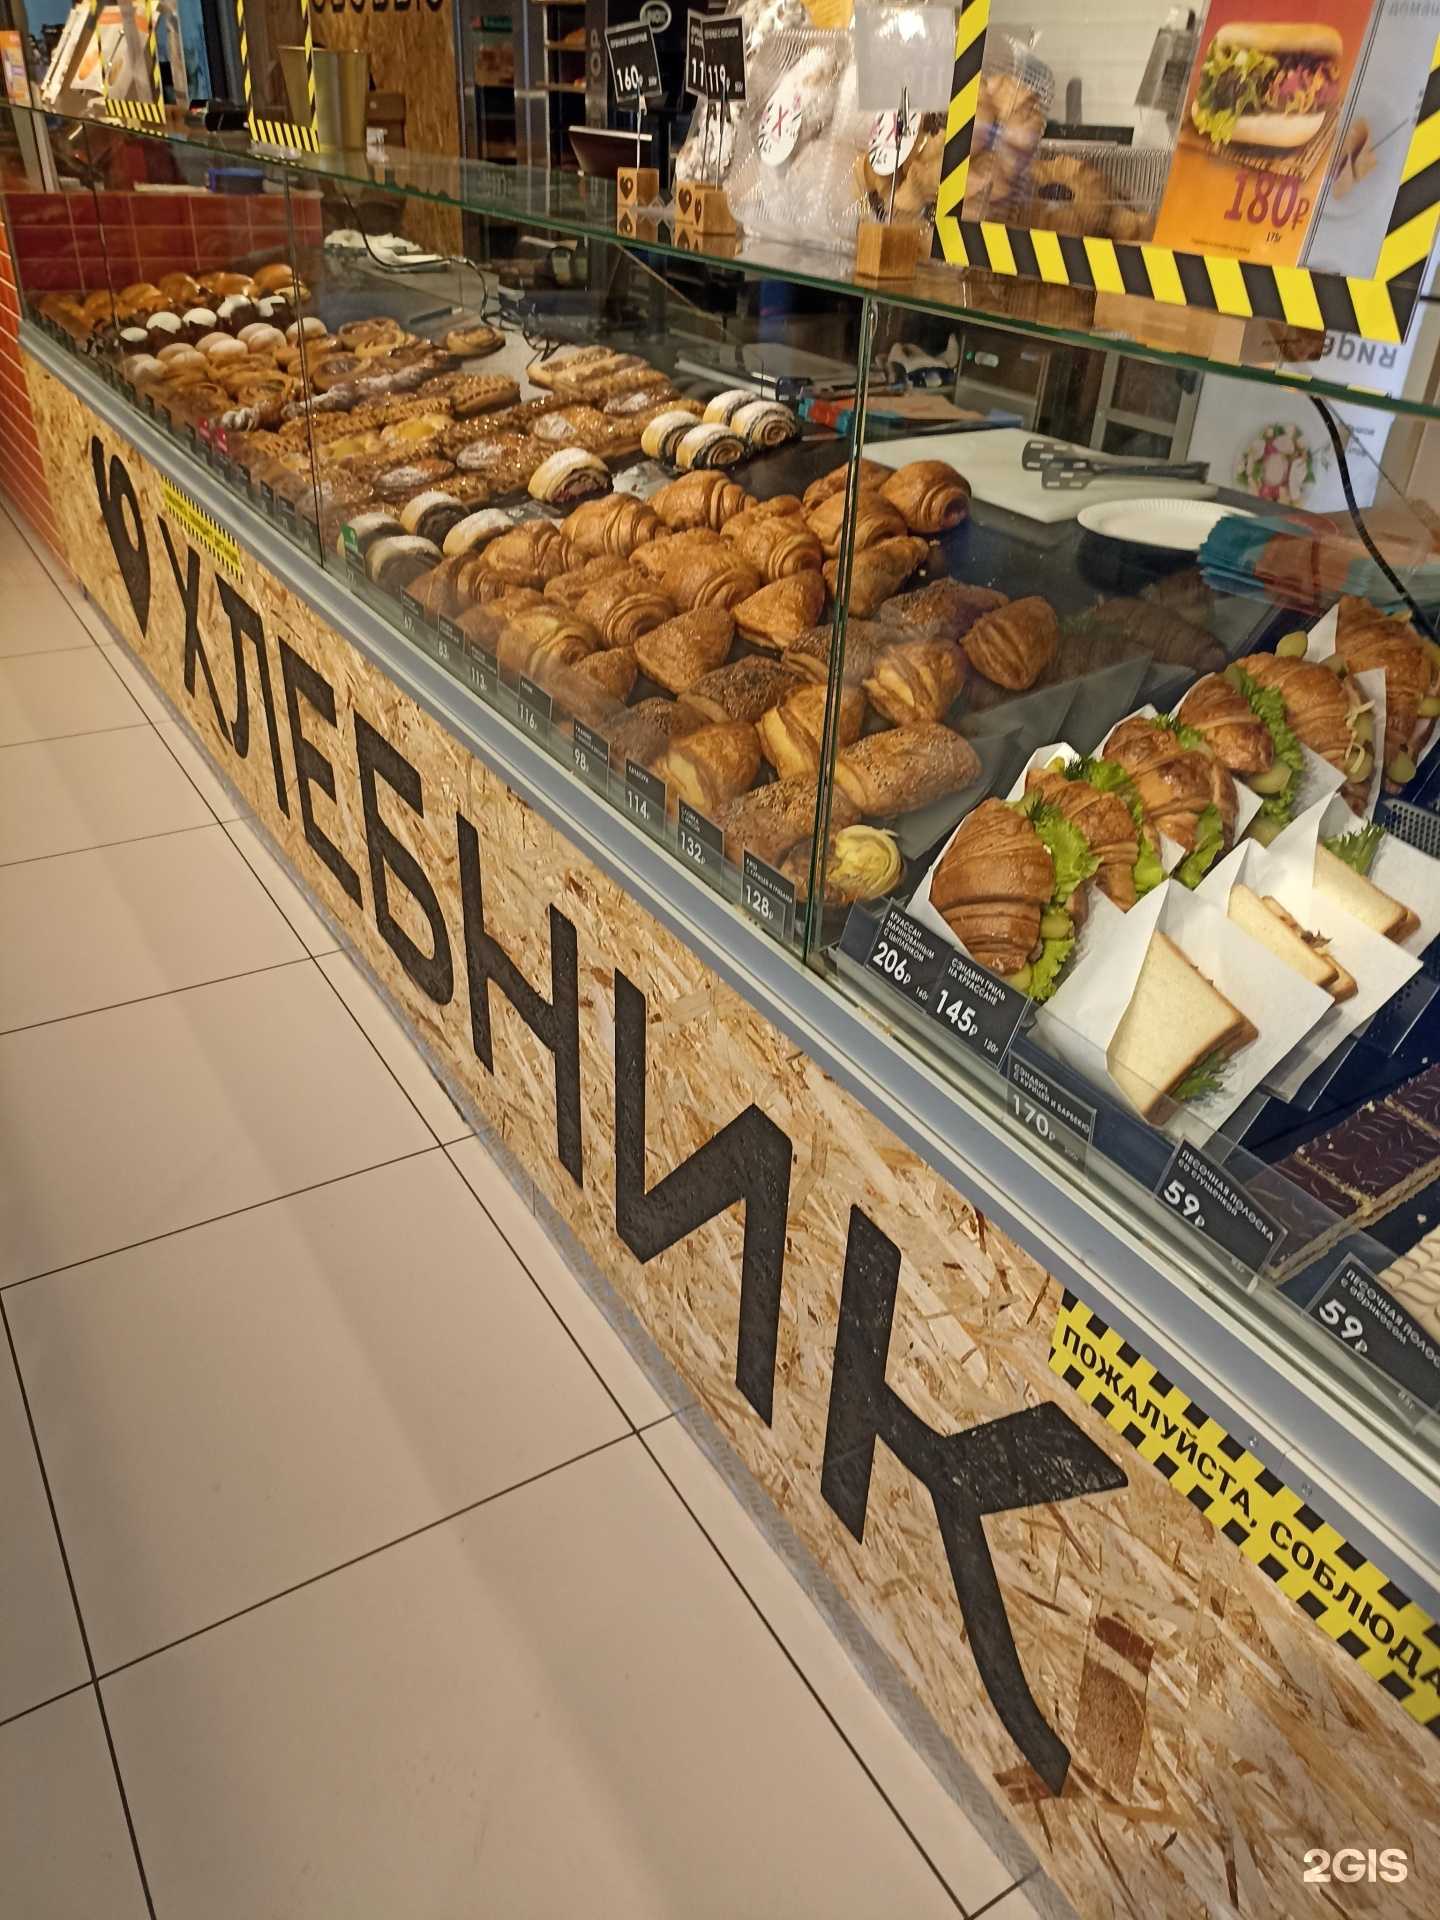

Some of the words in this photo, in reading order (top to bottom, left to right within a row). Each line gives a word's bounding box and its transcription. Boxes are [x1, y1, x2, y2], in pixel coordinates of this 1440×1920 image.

[887, 920, 935, 960] МАРИНОВАННЫМ
[890, 911, 922, 939] КРУАССАН
[948, 967, 957, 979] НА
[958, 976, 998, 1006] КРУАССАНЕ
[951, 958, 985, 985] СЭНДВИЧ
[985, 980, 1006, 1001] ГРИЛЬ
[1014, 1063, 1048, 1093] СЭНДВИЧ
[1057, 1103, 1090, 1134] БАРБЕКЮ
[157, 514, 1128, 1796] ХЛЕБНИК
[1182, 1149, 1230, 1198] ПЕСОЧНАЯ
[1229, 1192, 1274, 1243] ПОЛОСКА
[1346, 1269, 1404, 1327] ПЕСОЧНАЯ
[1062, 1324, 1258, 1529] ПОЖАЛУЙСТА,
